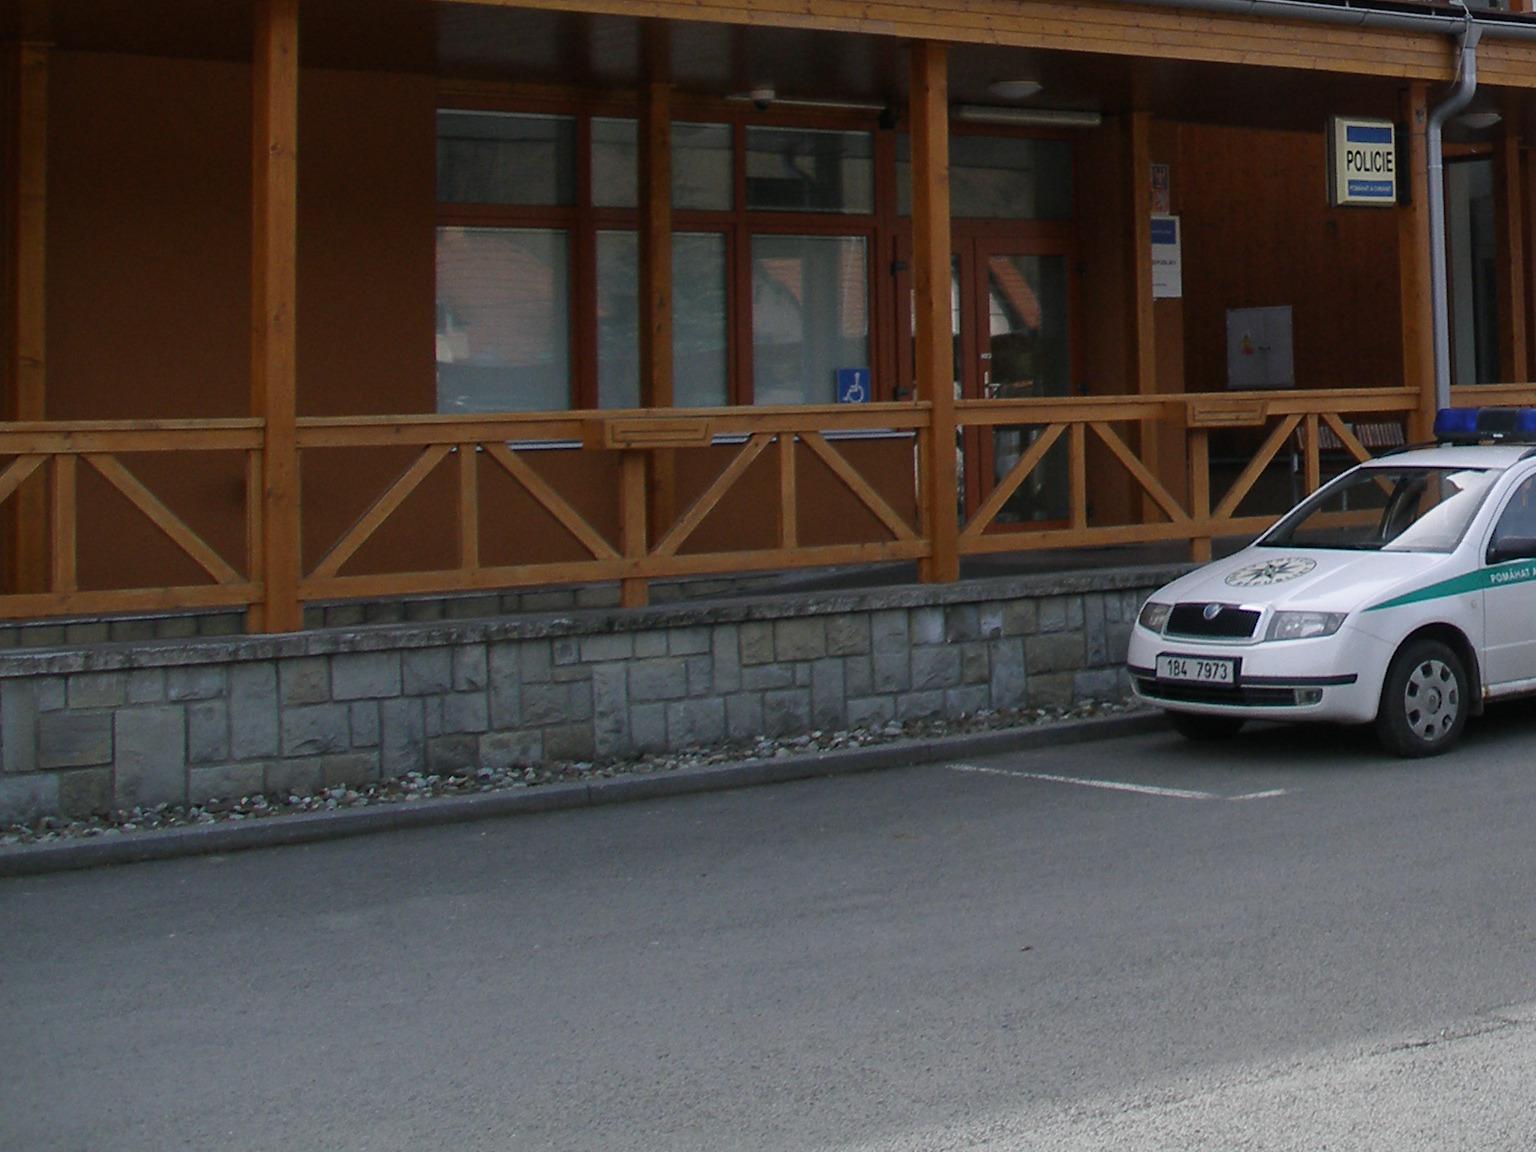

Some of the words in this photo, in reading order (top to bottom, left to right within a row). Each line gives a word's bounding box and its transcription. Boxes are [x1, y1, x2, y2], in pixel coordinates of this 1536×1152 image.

[1346, 150, 1394, 173] POLICIE
[1490, 568, 1531, 584] POMÁHAT
[1196, 661, 1228, 680] 7973
